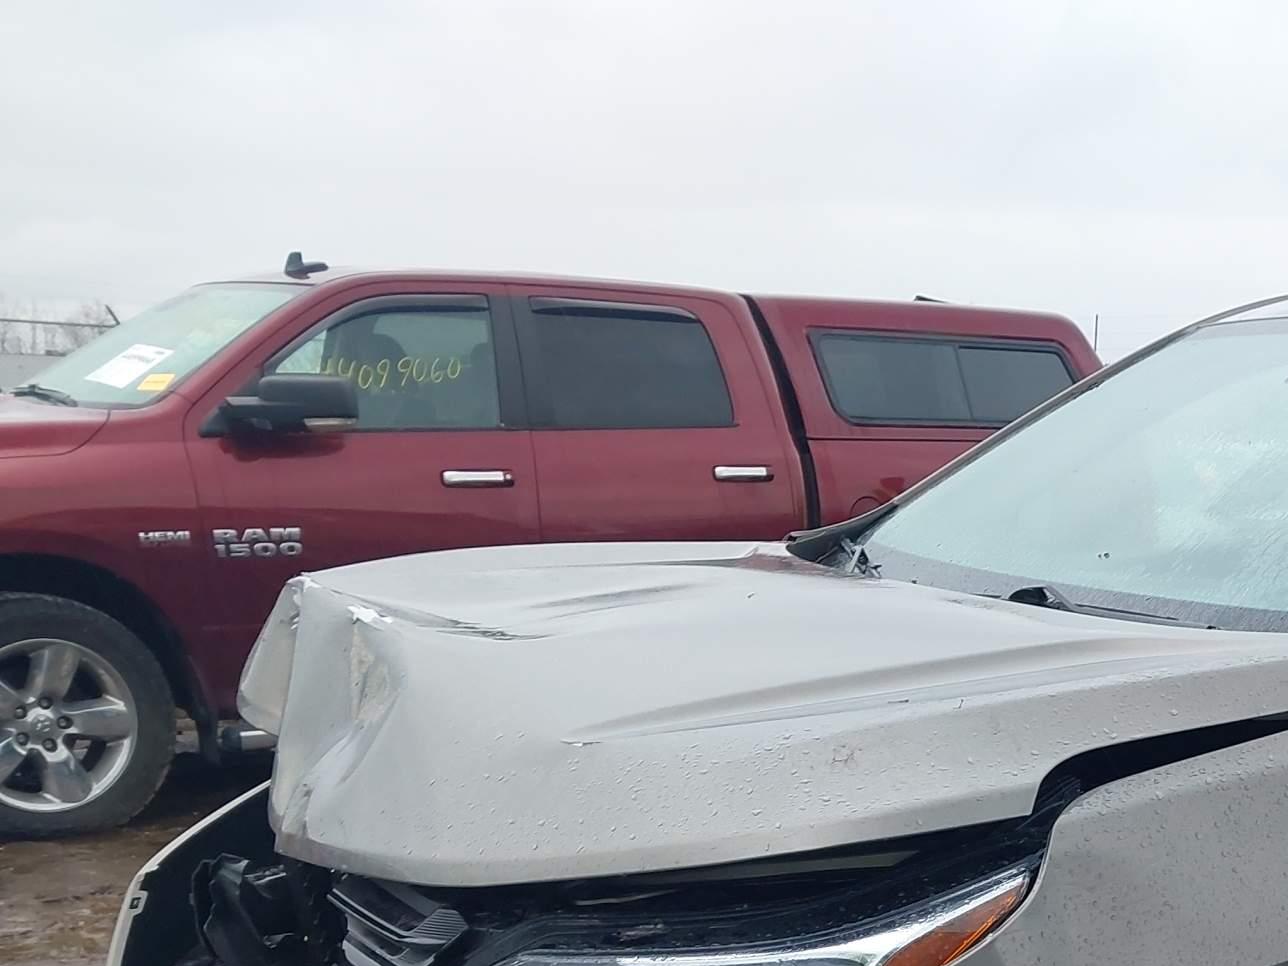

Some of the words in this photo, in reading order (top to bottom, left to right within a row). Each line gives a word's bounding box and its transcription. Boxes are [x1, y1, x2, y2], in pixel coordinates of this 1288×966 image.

[138, 531, 190, 543] HEMI
[212, 527, 301, 542] RAM
[213, 542, 303, 557] 1500
